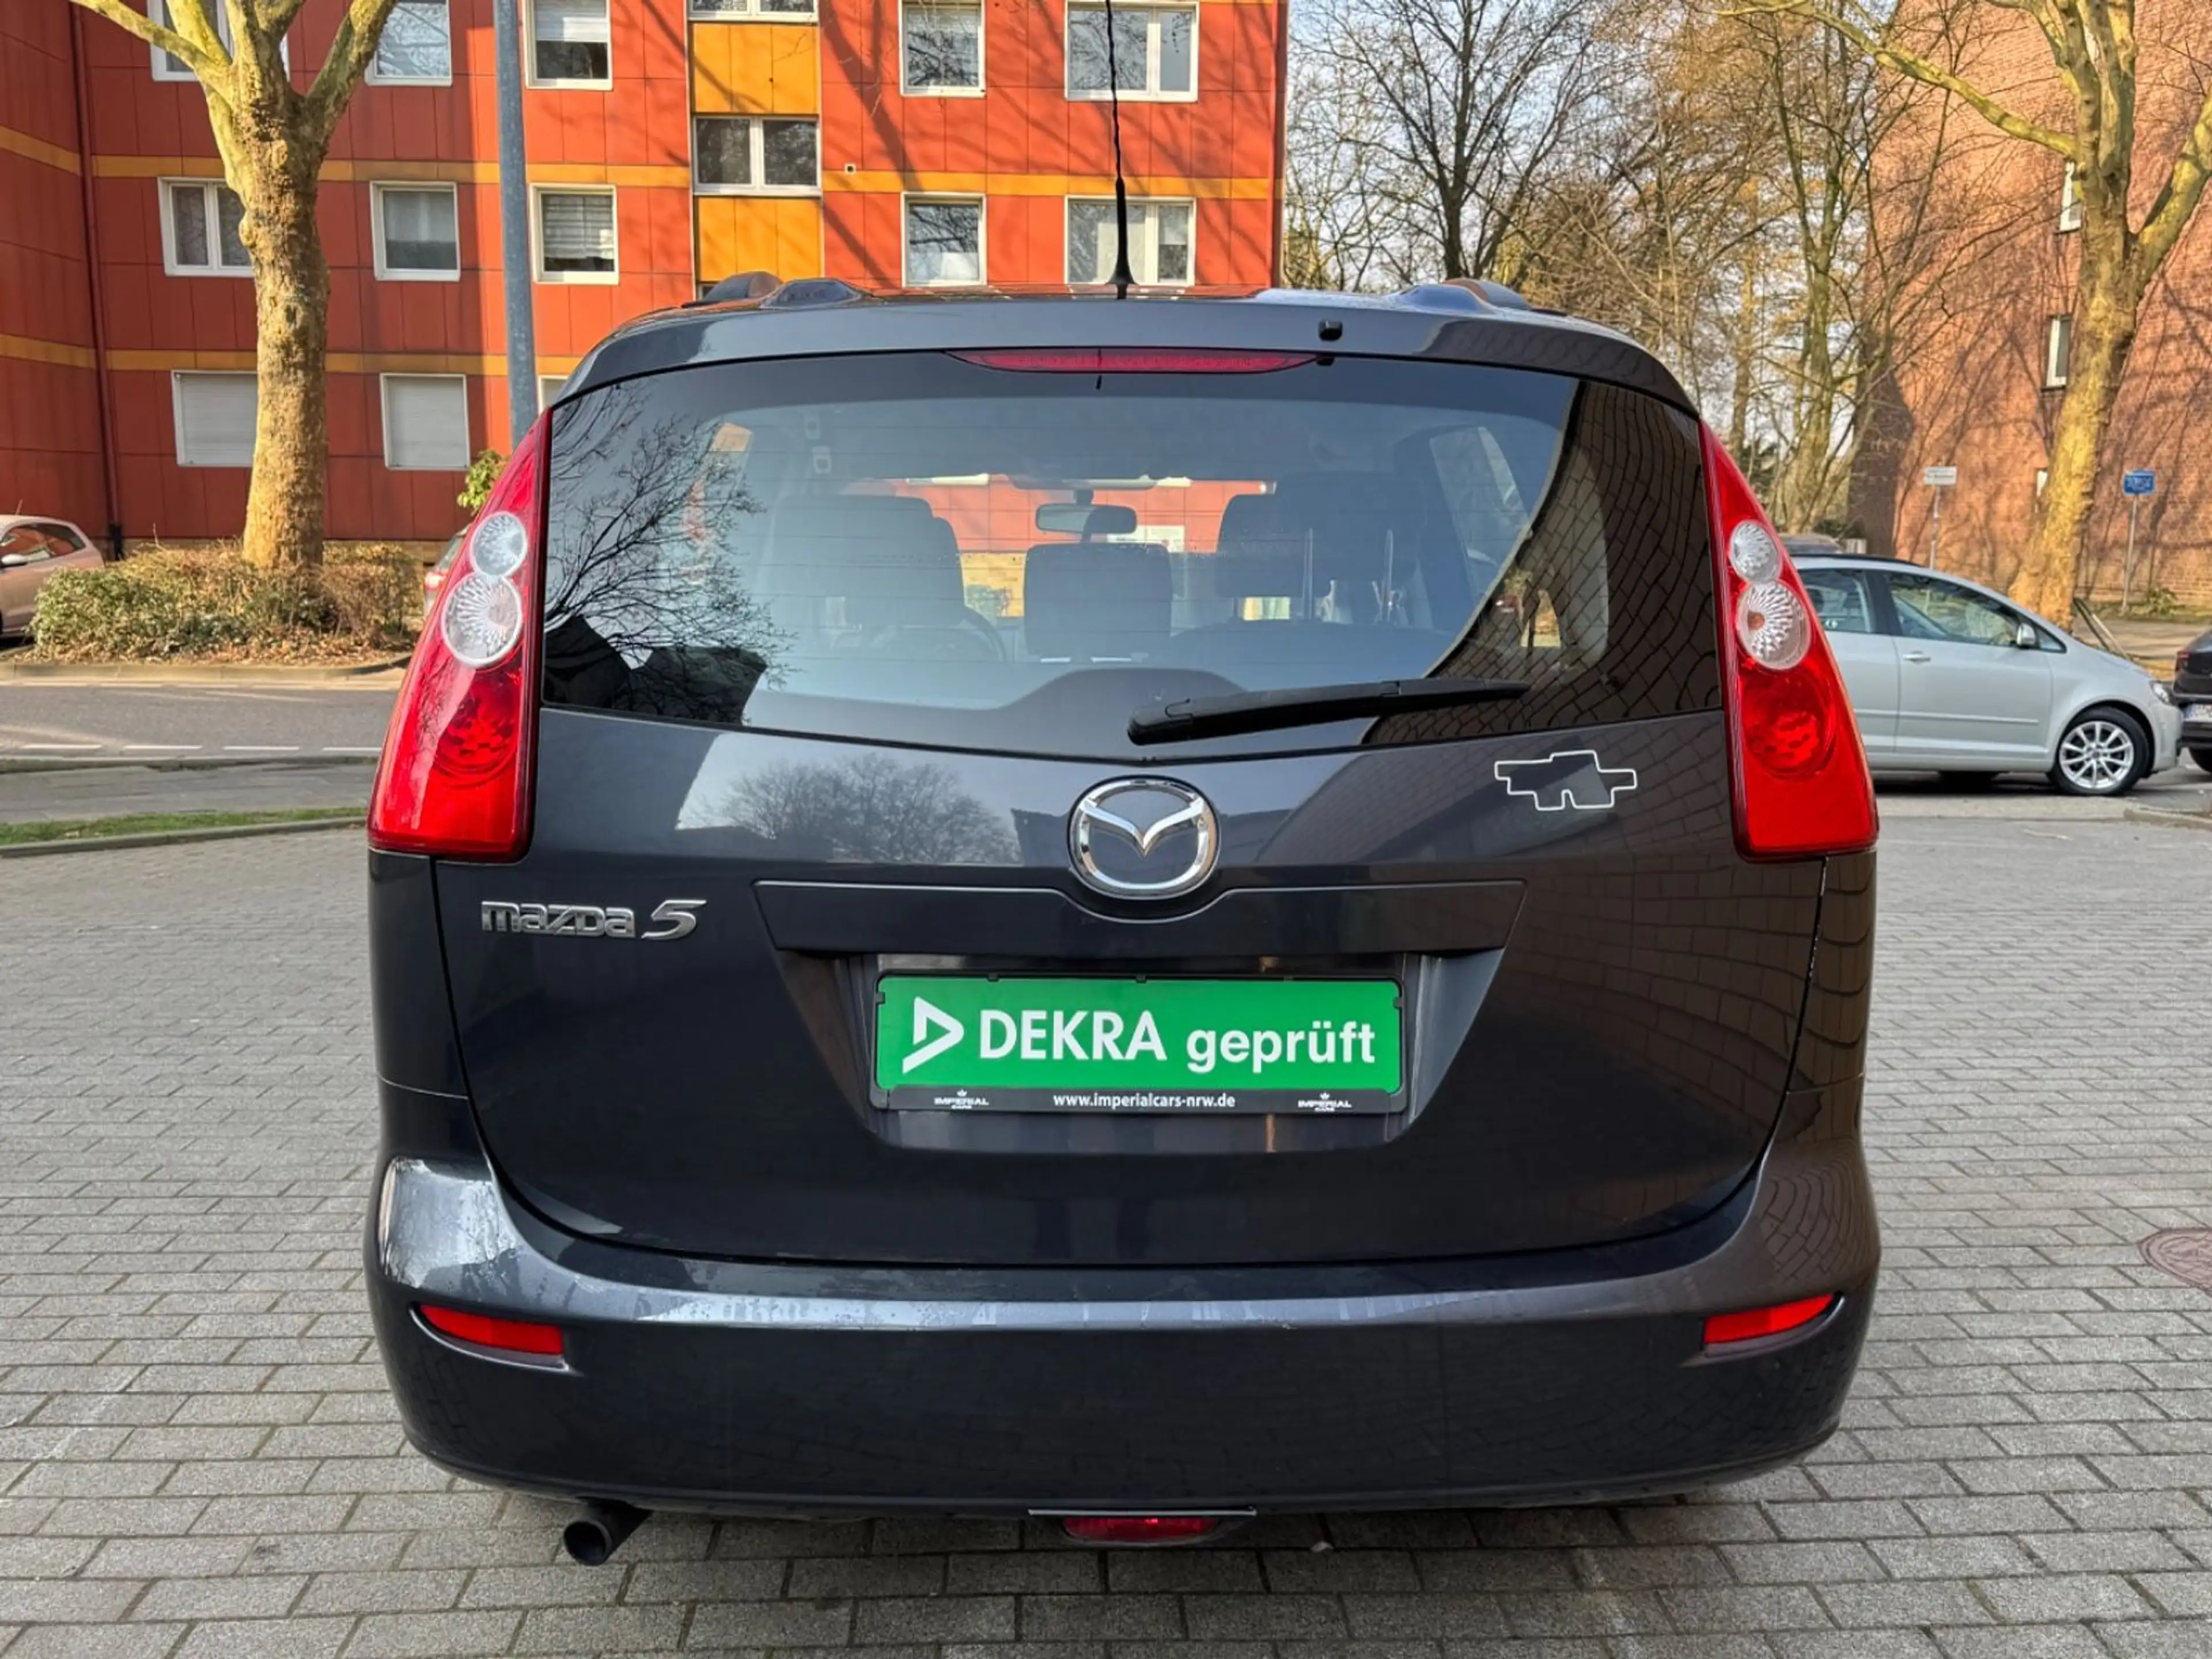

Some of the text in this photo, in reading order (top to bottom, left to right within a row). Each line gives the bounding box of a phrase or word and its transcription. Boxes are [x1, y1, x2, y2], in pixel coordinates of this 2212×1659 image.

[641, 899, 707, 940] 5
[980, 1009, 1375, 1073] DEKRA geprüft
[934, 1097, 990, 1105] IMPERIAL
[1052, 1092, 1236, 1111] www.imperialcars-nrw.de
[1297, 1099, 1353, 1108] IMPERIAL
